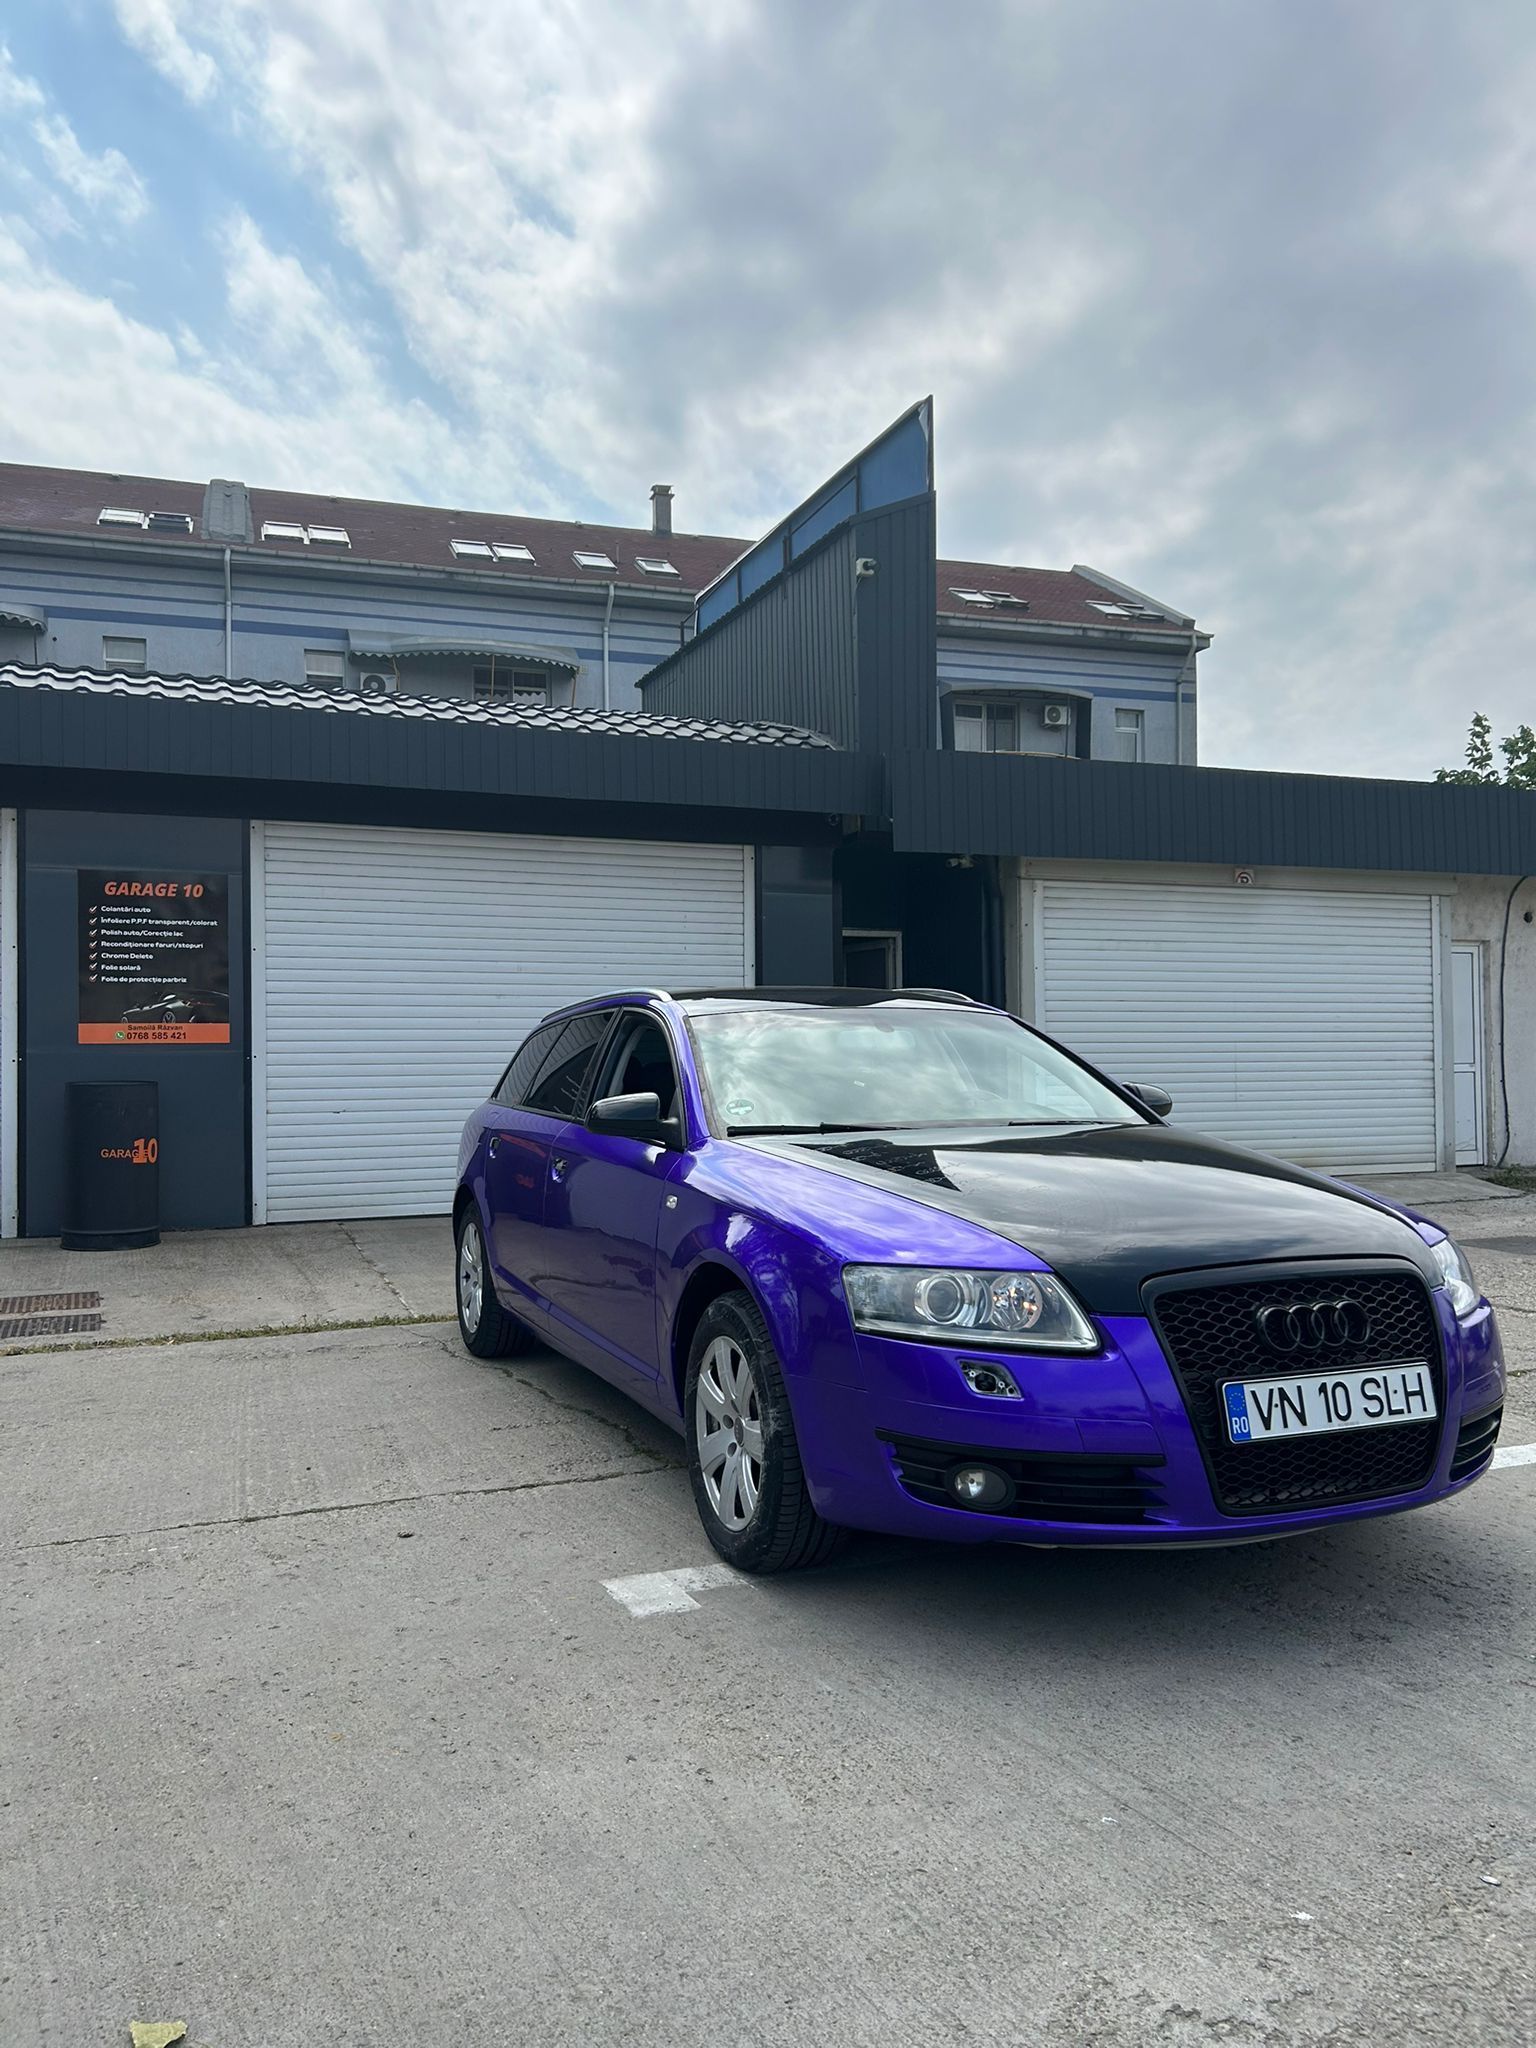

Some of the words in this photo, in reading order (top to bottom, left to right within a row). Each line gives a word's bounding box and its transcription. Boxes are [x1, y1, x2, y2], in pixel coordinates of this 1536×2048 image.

[104, 881, 179, 897] GARAGE
[183, 884, 204, 898] 10
[148, 919, 218, 927] transparent/colorat
[155, 941, 204, 949] faruri/stopuri
[126, 1032, 149, 1040] 0768
[151, 1032, 169, 1040] 585
[170, 1032, 187, 1040] 421
[132, 1138, 158, 1164] 10
[1250, 1385, 1308, 1431] VN
[1318, 1381, 1351, 1423] 10
[1360, 1372, 1428, 1418] SLH
[1232, 1416, 1248, 1434] RO
